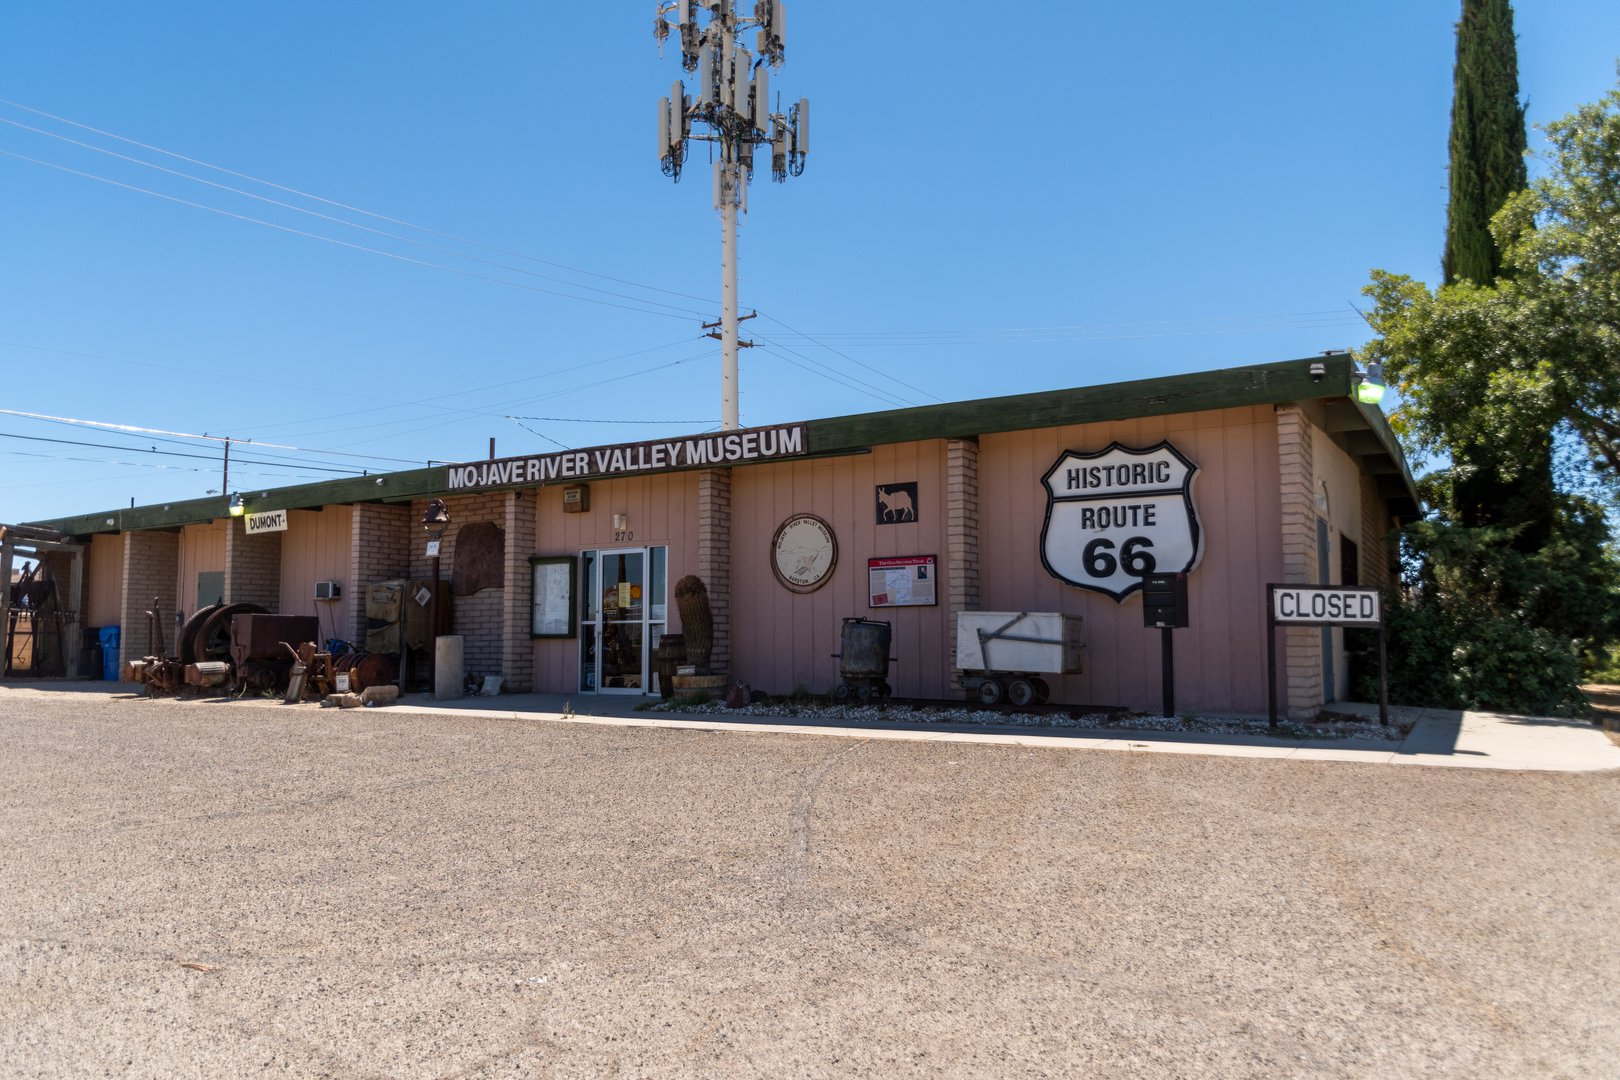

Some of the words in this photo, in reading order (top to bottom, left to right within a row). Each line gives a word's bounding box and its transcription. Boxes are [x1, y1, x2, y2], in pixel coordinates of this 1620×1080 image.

[448, 461, 524, 488] MOJAVE
[527, 452, 589, 481] RIVER
[595, 442, 682, 473] VALLEY
[686, 427, 801, 465] MUSEUM
[1066, 461, 1170, 489] HISTORIC
[249, 514, 282, 530] DUMONT
[1081, 504, 1156, 529] ROUTE
[615, 531, 634, 542] 270
[777, 531, 788, 549] MOJAVE
[789, 520, 801, 529] RIVER
[818, 525, 831, 543] MUSEUM
[1082, 536, 1157, 578] 66
[1280, 592, 1374, 619] CLOSED
